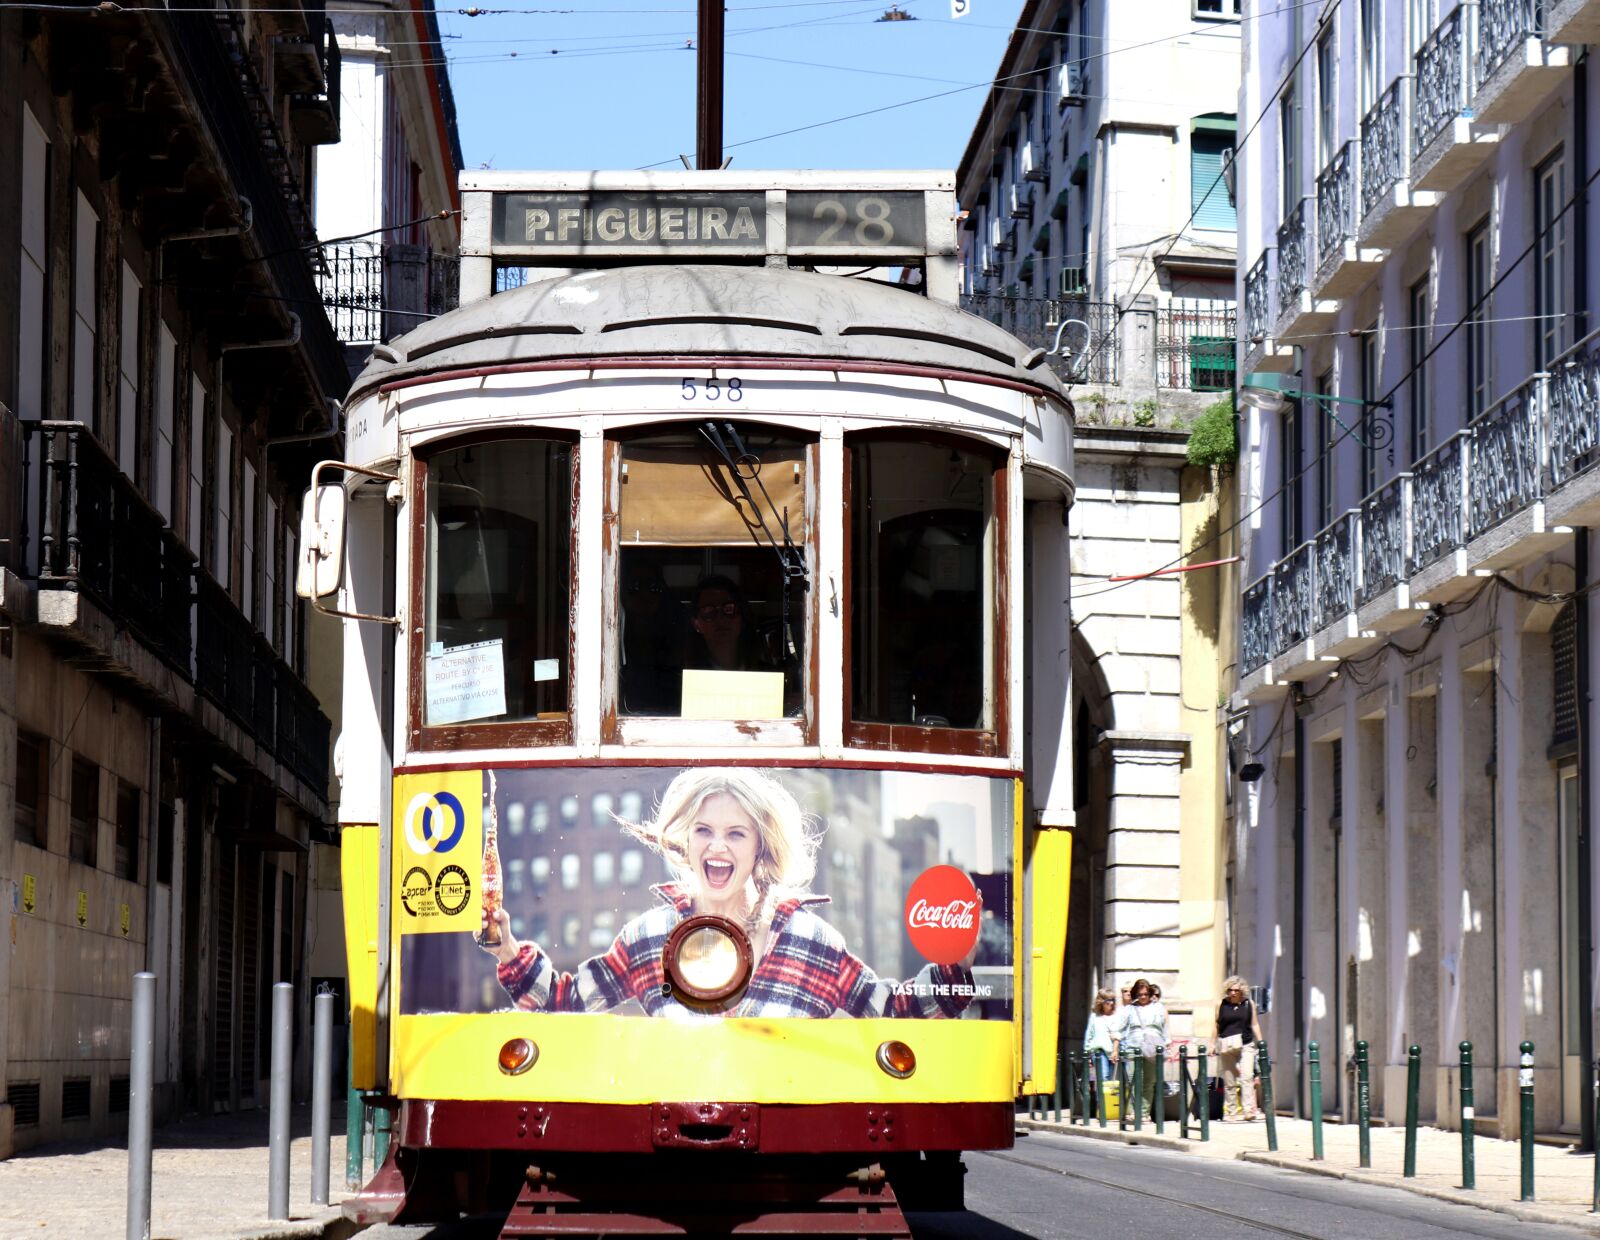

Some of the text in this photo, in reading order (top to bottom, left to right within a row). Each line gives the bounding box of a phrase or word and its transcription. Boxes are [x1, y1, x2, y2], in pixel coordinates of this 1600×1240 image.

[525, 207, 760, 242] P.FIGUEIRA
[812, 198, 895, 246] 28
[682, 377, 743, 402] 558
[441, 655, 487, 668] ALTERNATIVE
[435, 670, 459, 680] ROUTE
[462, 668, 471, 676] BY
[451, 680, 481, 691] PERCURSO
[432, 694, 471, 705] ALTERNATIVO
[406, 887, 428, 899] apcer
[909, 899, 976, 929] Coca-Cola
[891, 984, 992, 997] TASTE THE FEELING
